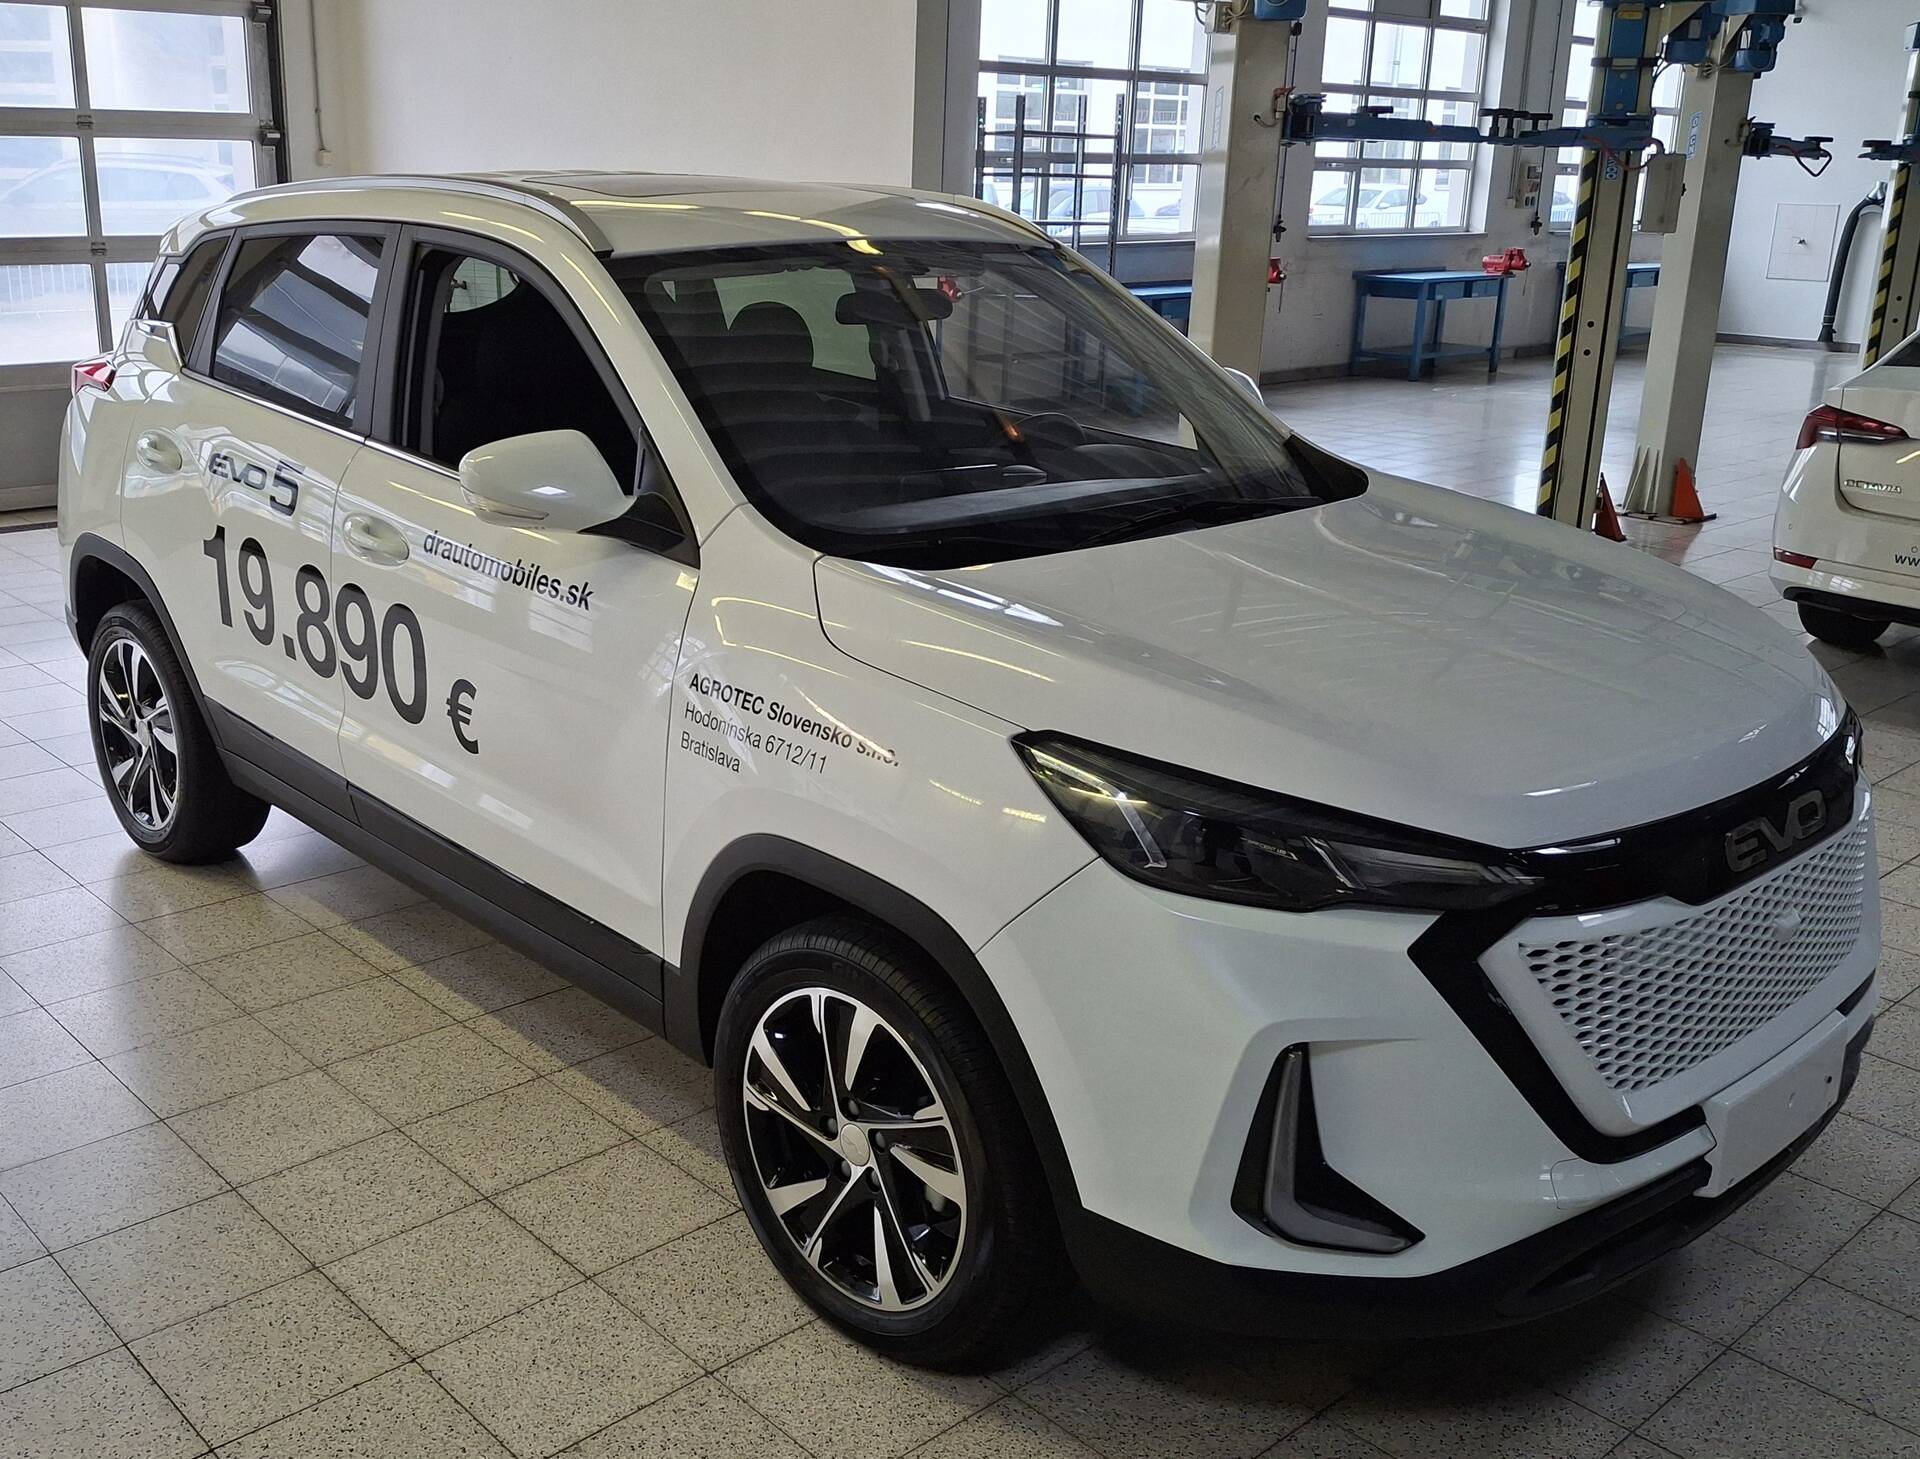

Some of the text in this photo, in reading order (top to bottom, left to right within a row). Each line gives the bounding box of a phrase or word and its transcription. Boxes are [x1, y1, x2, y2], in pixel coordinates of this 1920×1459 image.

[423, 530, 594, 611] drautomobiles.sk
[203, 525, 479, 755] 19.890 €
[684, 701, 828, 774] Hodonínska 6712/11
[689, 673, 765, 715] AGROTEC
[767, 702, 853, 749] Slovensko
[680, 730, 741, 774] Bratislava
[1724, 789, 1827, 873] EVO
